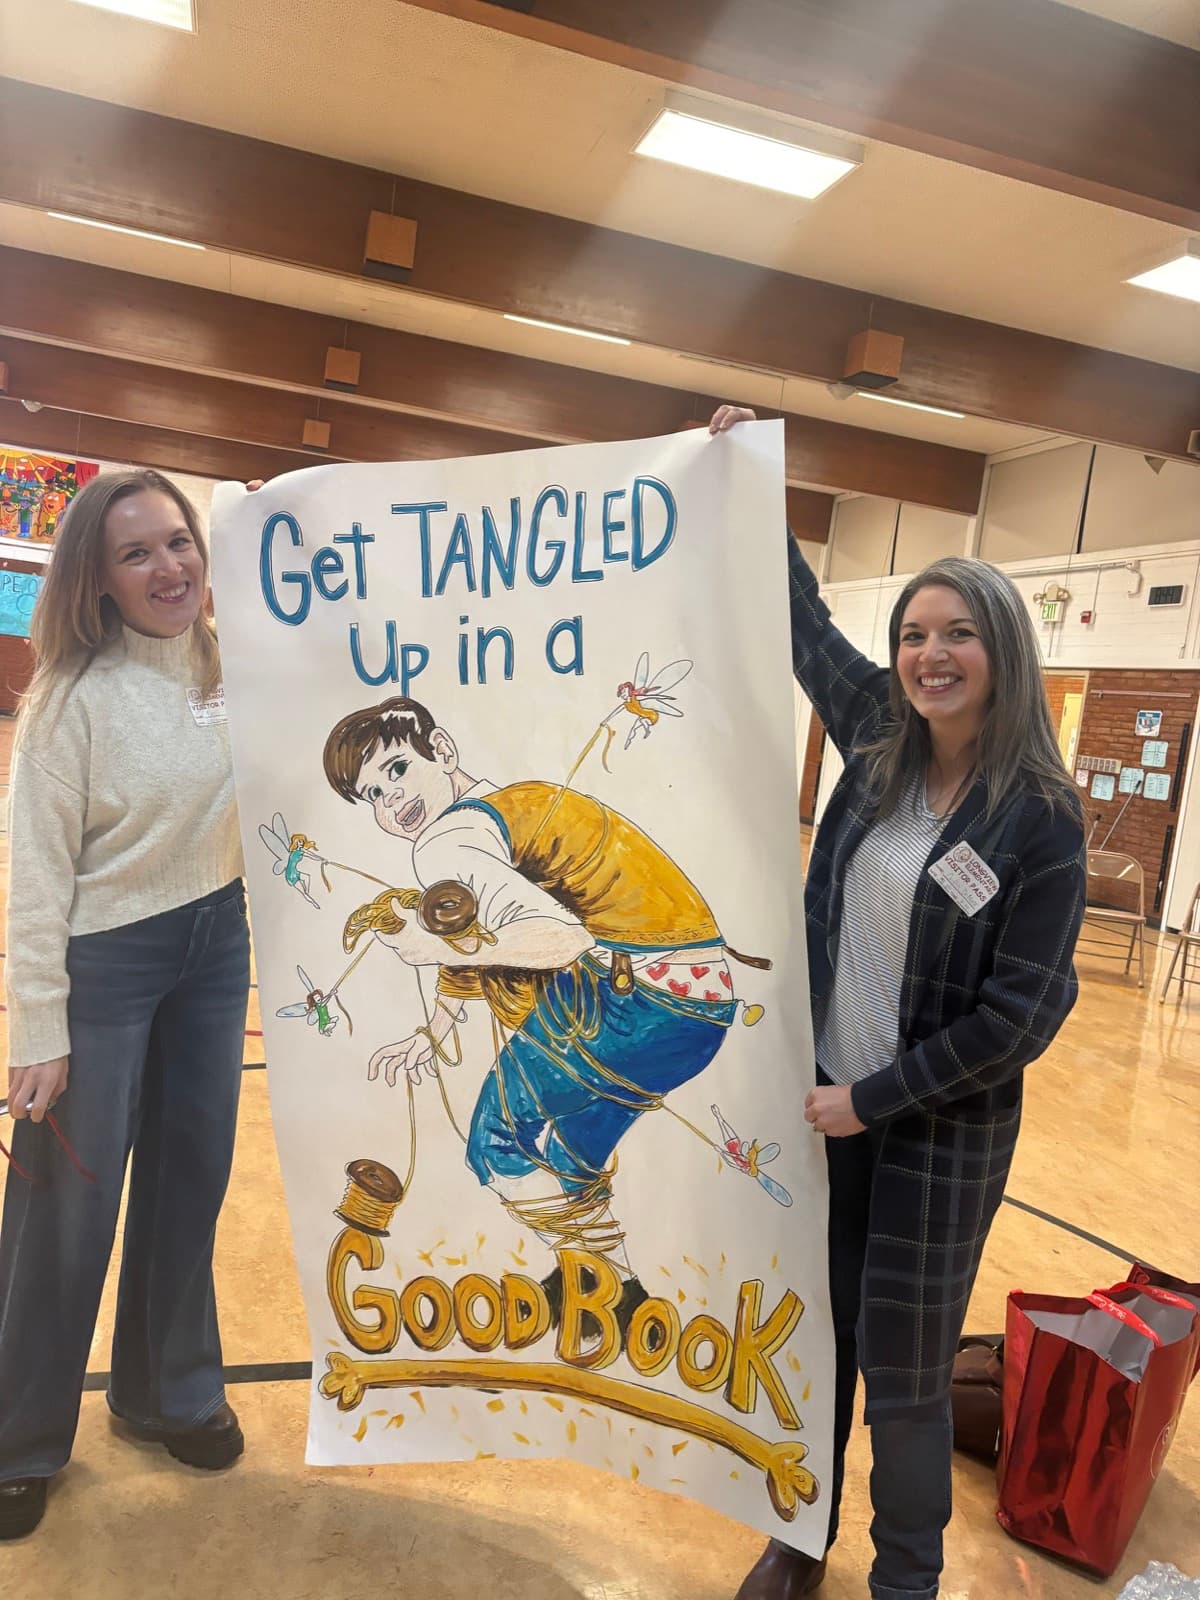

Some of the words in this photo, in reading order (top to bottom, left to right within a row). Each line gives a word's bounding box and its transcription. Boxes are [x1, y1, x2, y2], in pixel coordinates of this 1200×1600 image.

[259, 510, 376, 626] Get
[391, 475, 679, 599] TANGLED
[1041, 603, 1057, 620] EXIT
[349, 620, 430, 698] Up
[458, 615, 515, 686] in
[545, 615, 585, 676] a
[945, 855, 971, 884] VISITOR
[970, 883, 987, 902] PASS
[969, 859, 998, 892] LONGVIEW
[326, 1227, 551, 1354] GOOD
[555, 1247, 805, 1431] BOOK
